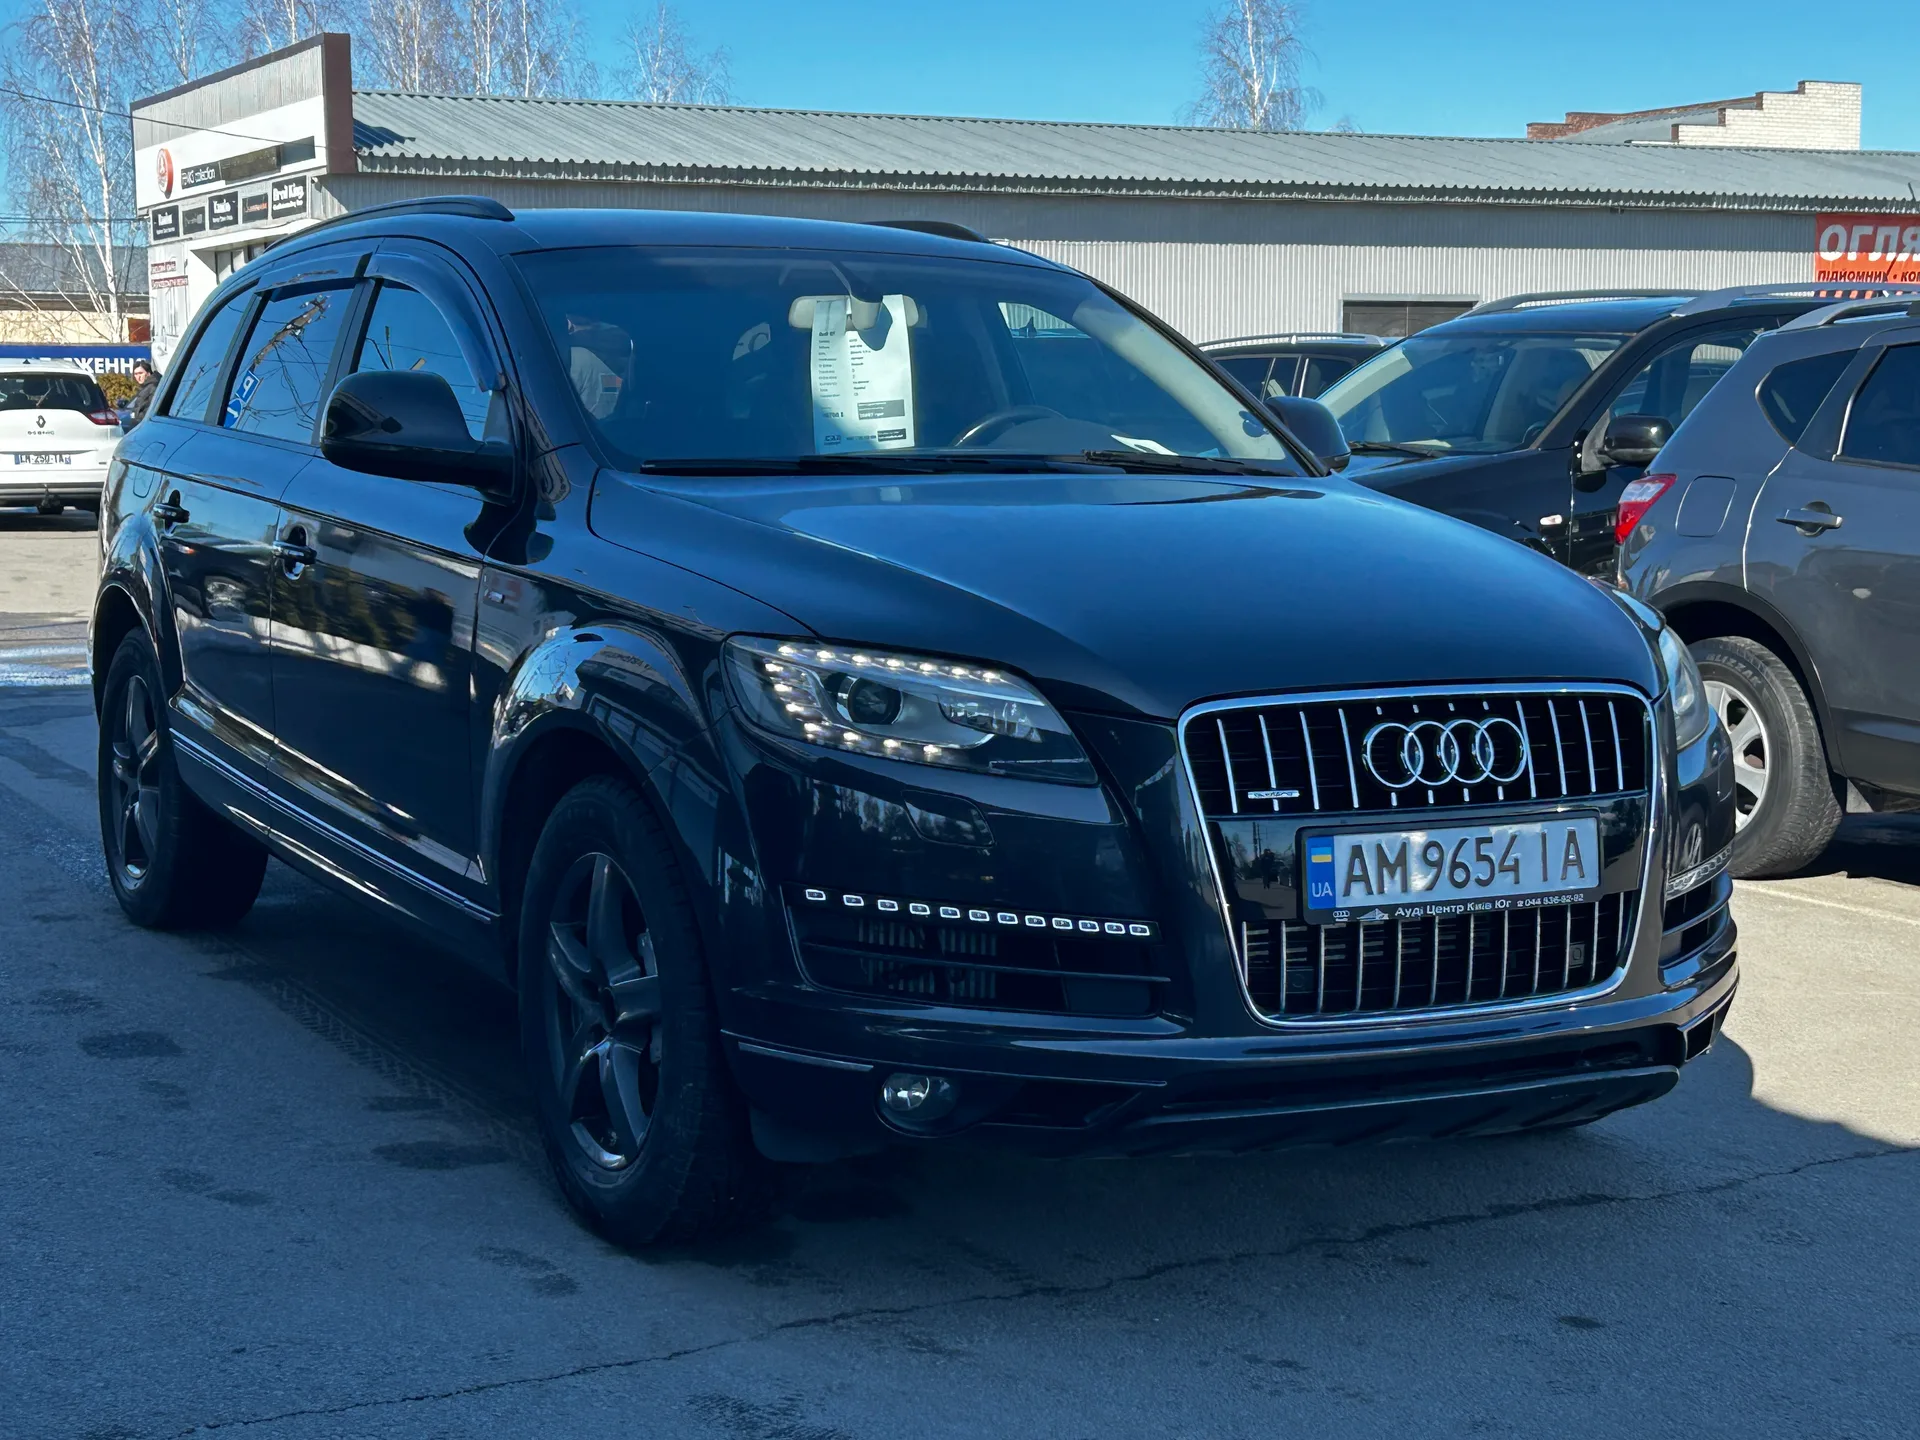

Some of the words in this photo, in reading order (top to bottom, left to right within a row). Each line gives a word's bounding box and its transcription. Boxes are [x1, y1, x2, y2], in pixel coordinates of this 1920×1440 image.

[1819, 224, 1920, 262] ОГЛЯ
[1343, 838, 1410, 897] AM
[1422, 832, 1520, 892] 9654
[1541, 827, 1585, 882] IA
[1311, 881, 1333, 898] UA
[1395, 906, 1424, 917] Ауді
[1426, 904, 1465, 915] Центр
[1495, 899, 1512, 909] Юг
